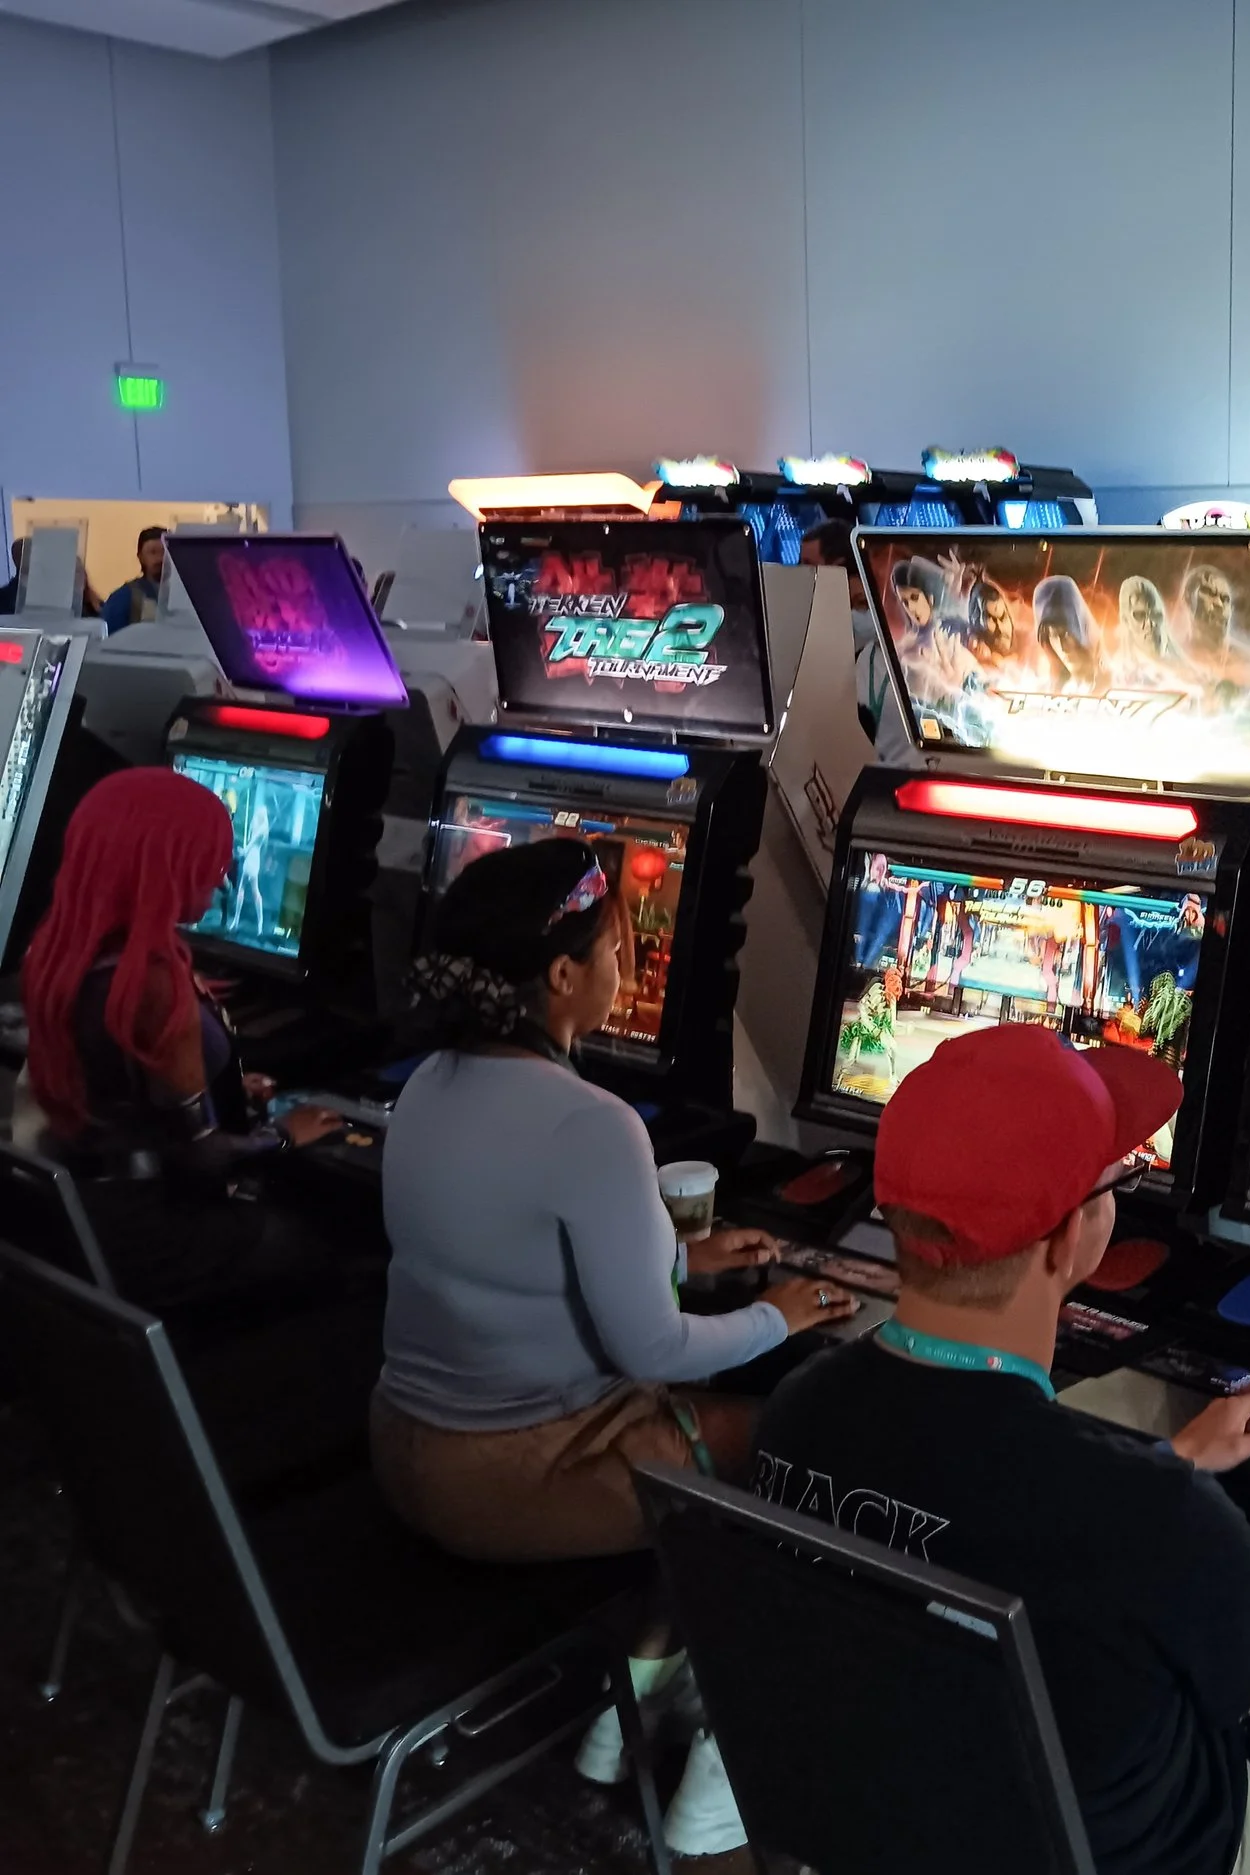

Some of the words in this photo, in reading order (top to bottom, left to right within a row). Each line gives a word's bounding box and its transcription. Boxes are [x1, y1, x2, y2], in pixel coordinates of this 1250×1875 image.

[528, 592, 628, 618] TEKKEN
[545, 615, 660, 662] TAG
[643, 602, 725, 665] 2
[588, 657, 728, 687] TOURNAMENT
